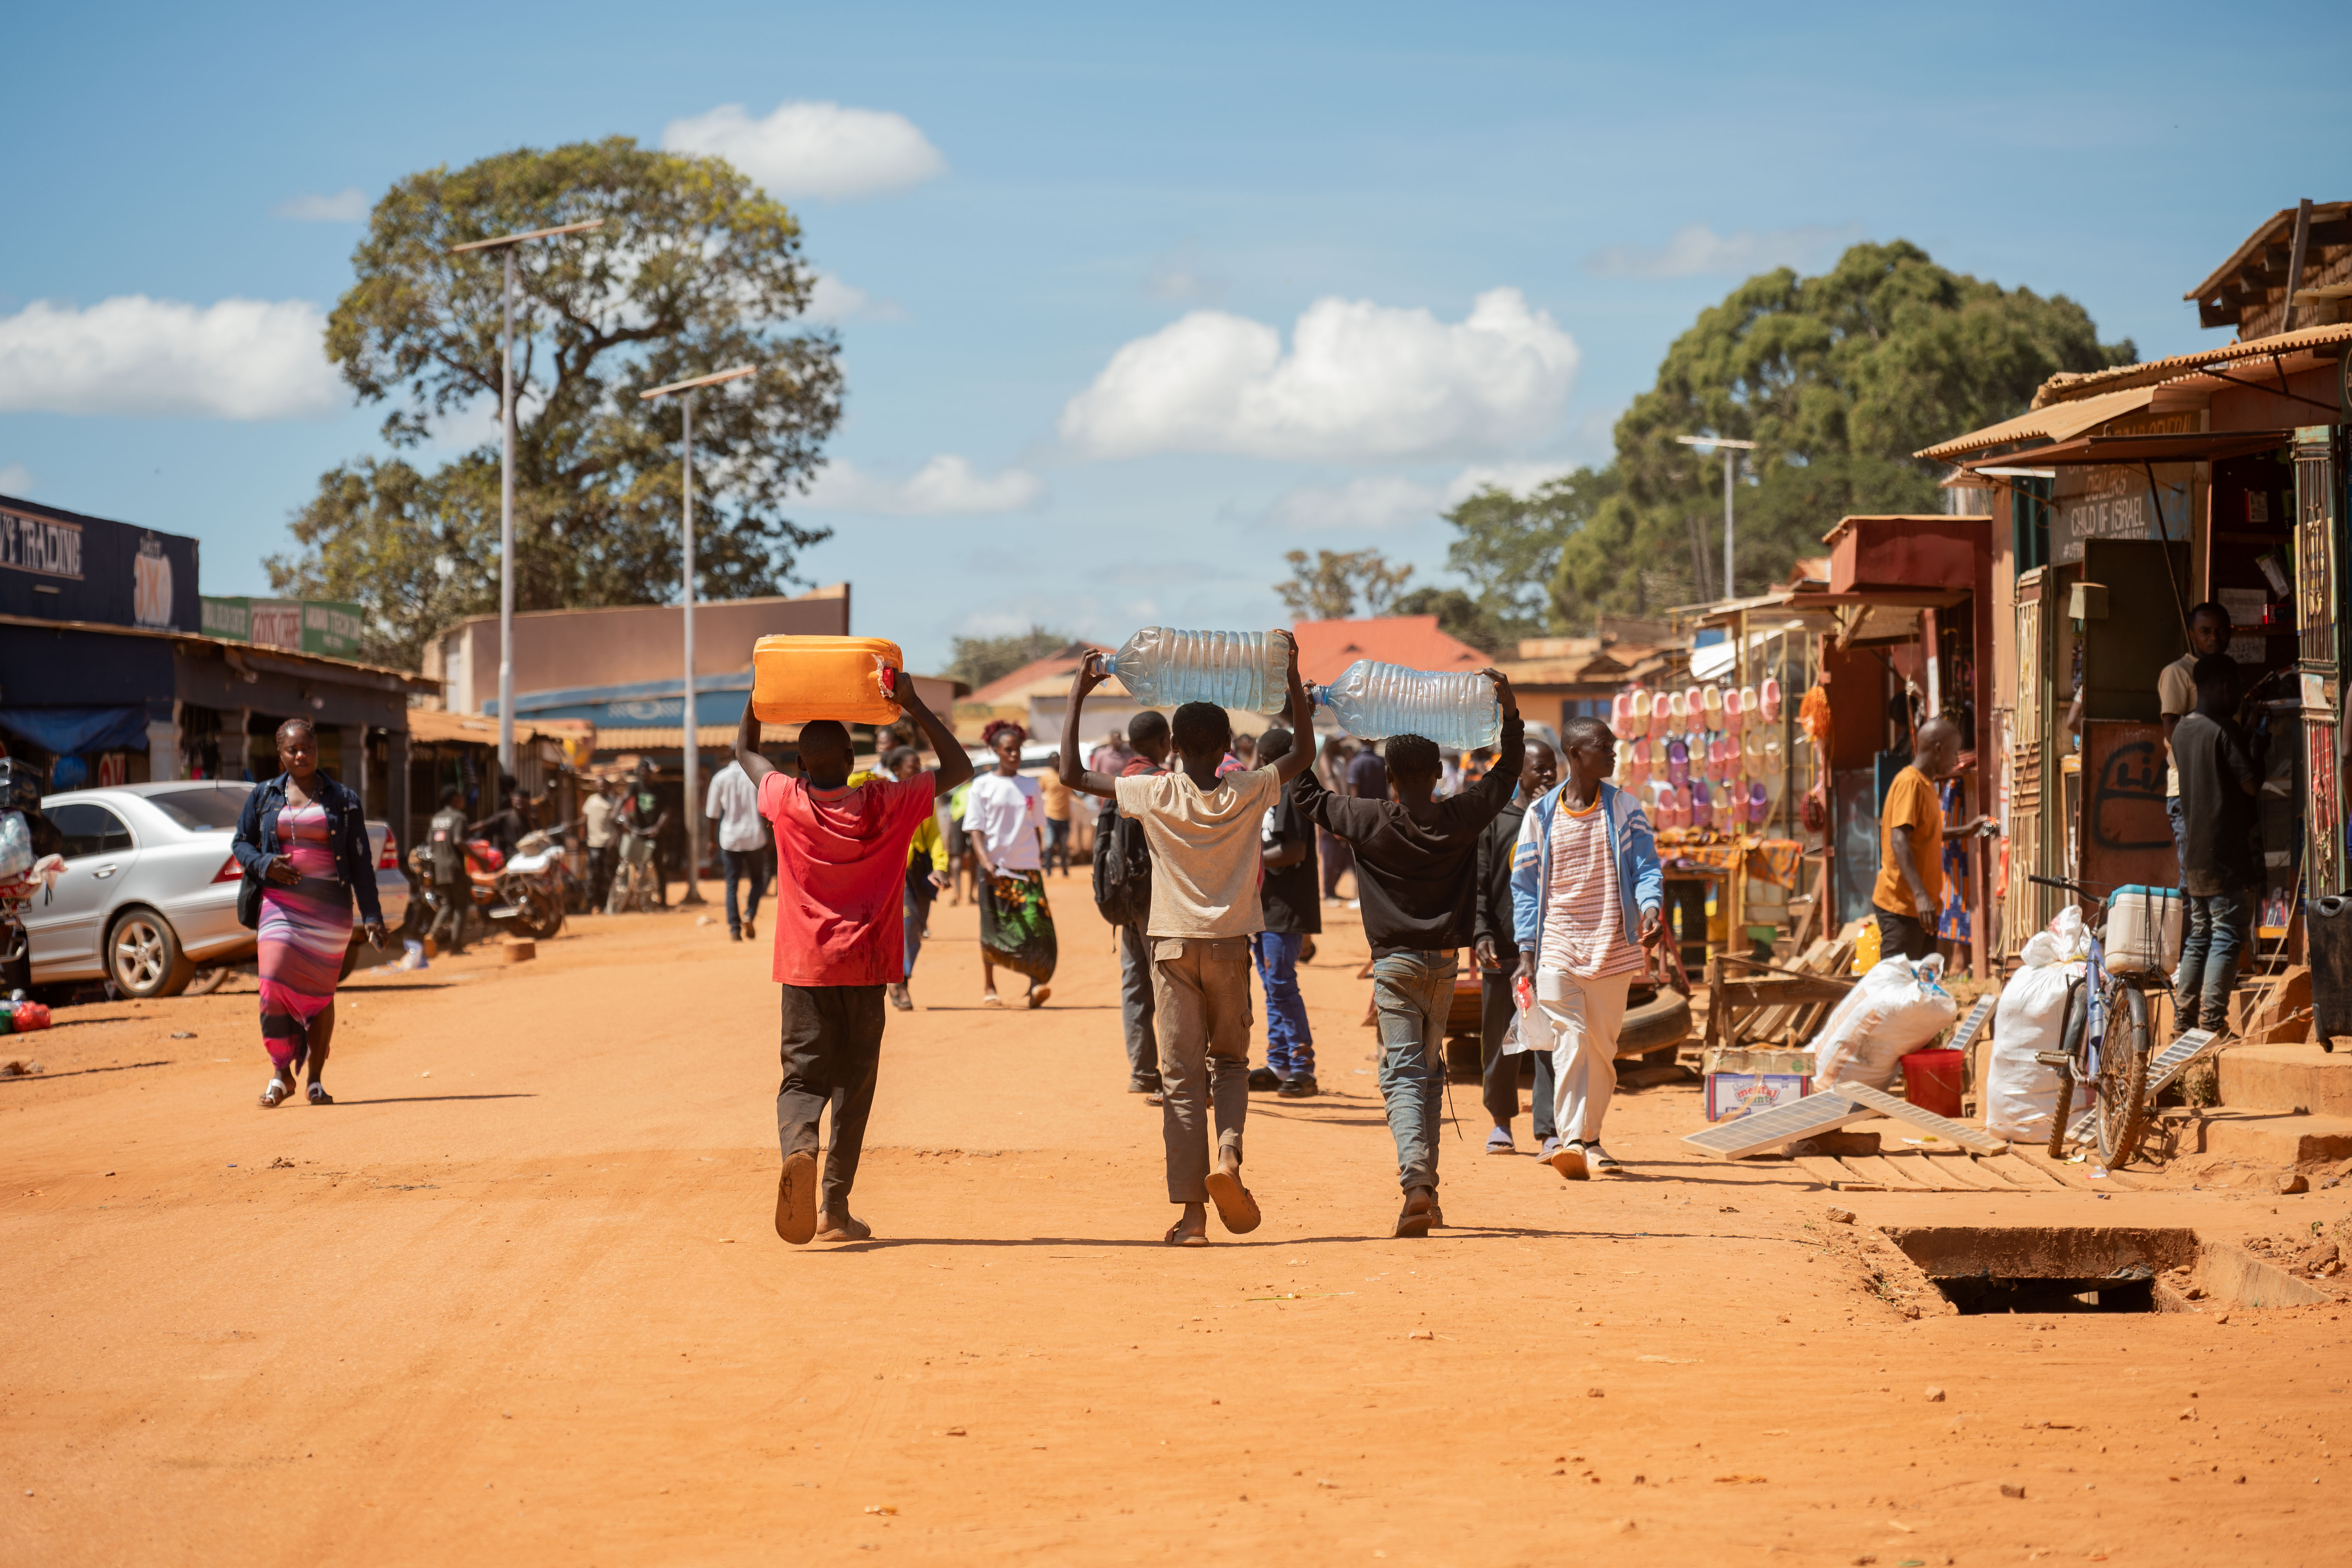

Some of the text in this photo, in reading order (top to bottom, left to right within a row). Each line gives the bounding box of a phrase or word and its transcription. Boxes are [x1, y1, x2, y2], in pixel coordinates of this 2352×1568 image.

[2071, 505, 2096, 537] CHILD
[2099, 502, 2108, 533] OF
[2110, 495, 2145, 532] ISRAEL
[19, 519, 81, 576] TRADING
